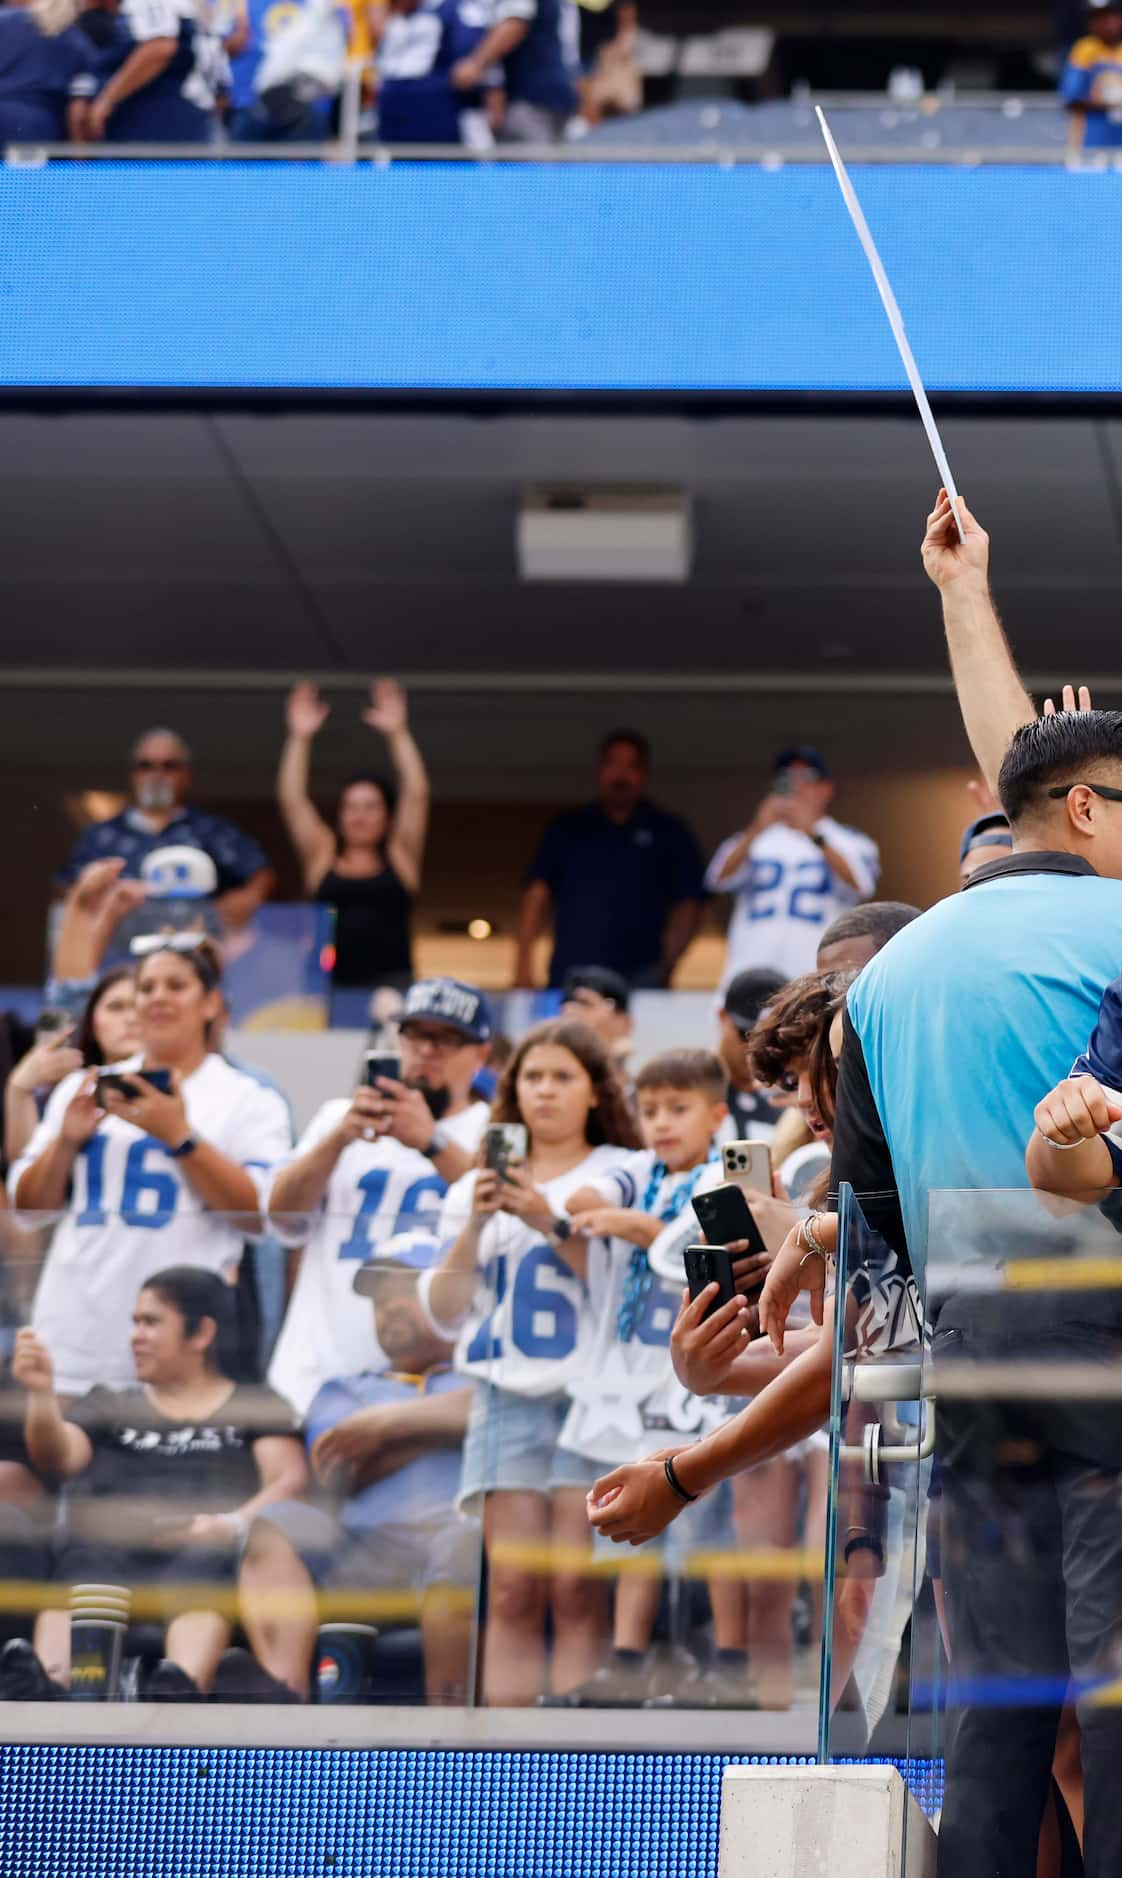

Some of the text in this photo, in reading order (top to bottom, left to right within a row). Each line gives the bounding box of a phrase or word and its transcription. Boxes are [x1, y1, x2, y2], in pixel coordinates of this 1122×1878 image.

[746, 859, 832, 922] 22
[77, 1132, 178, 1229] 16
[338, 1168, 448, 1260] 16
